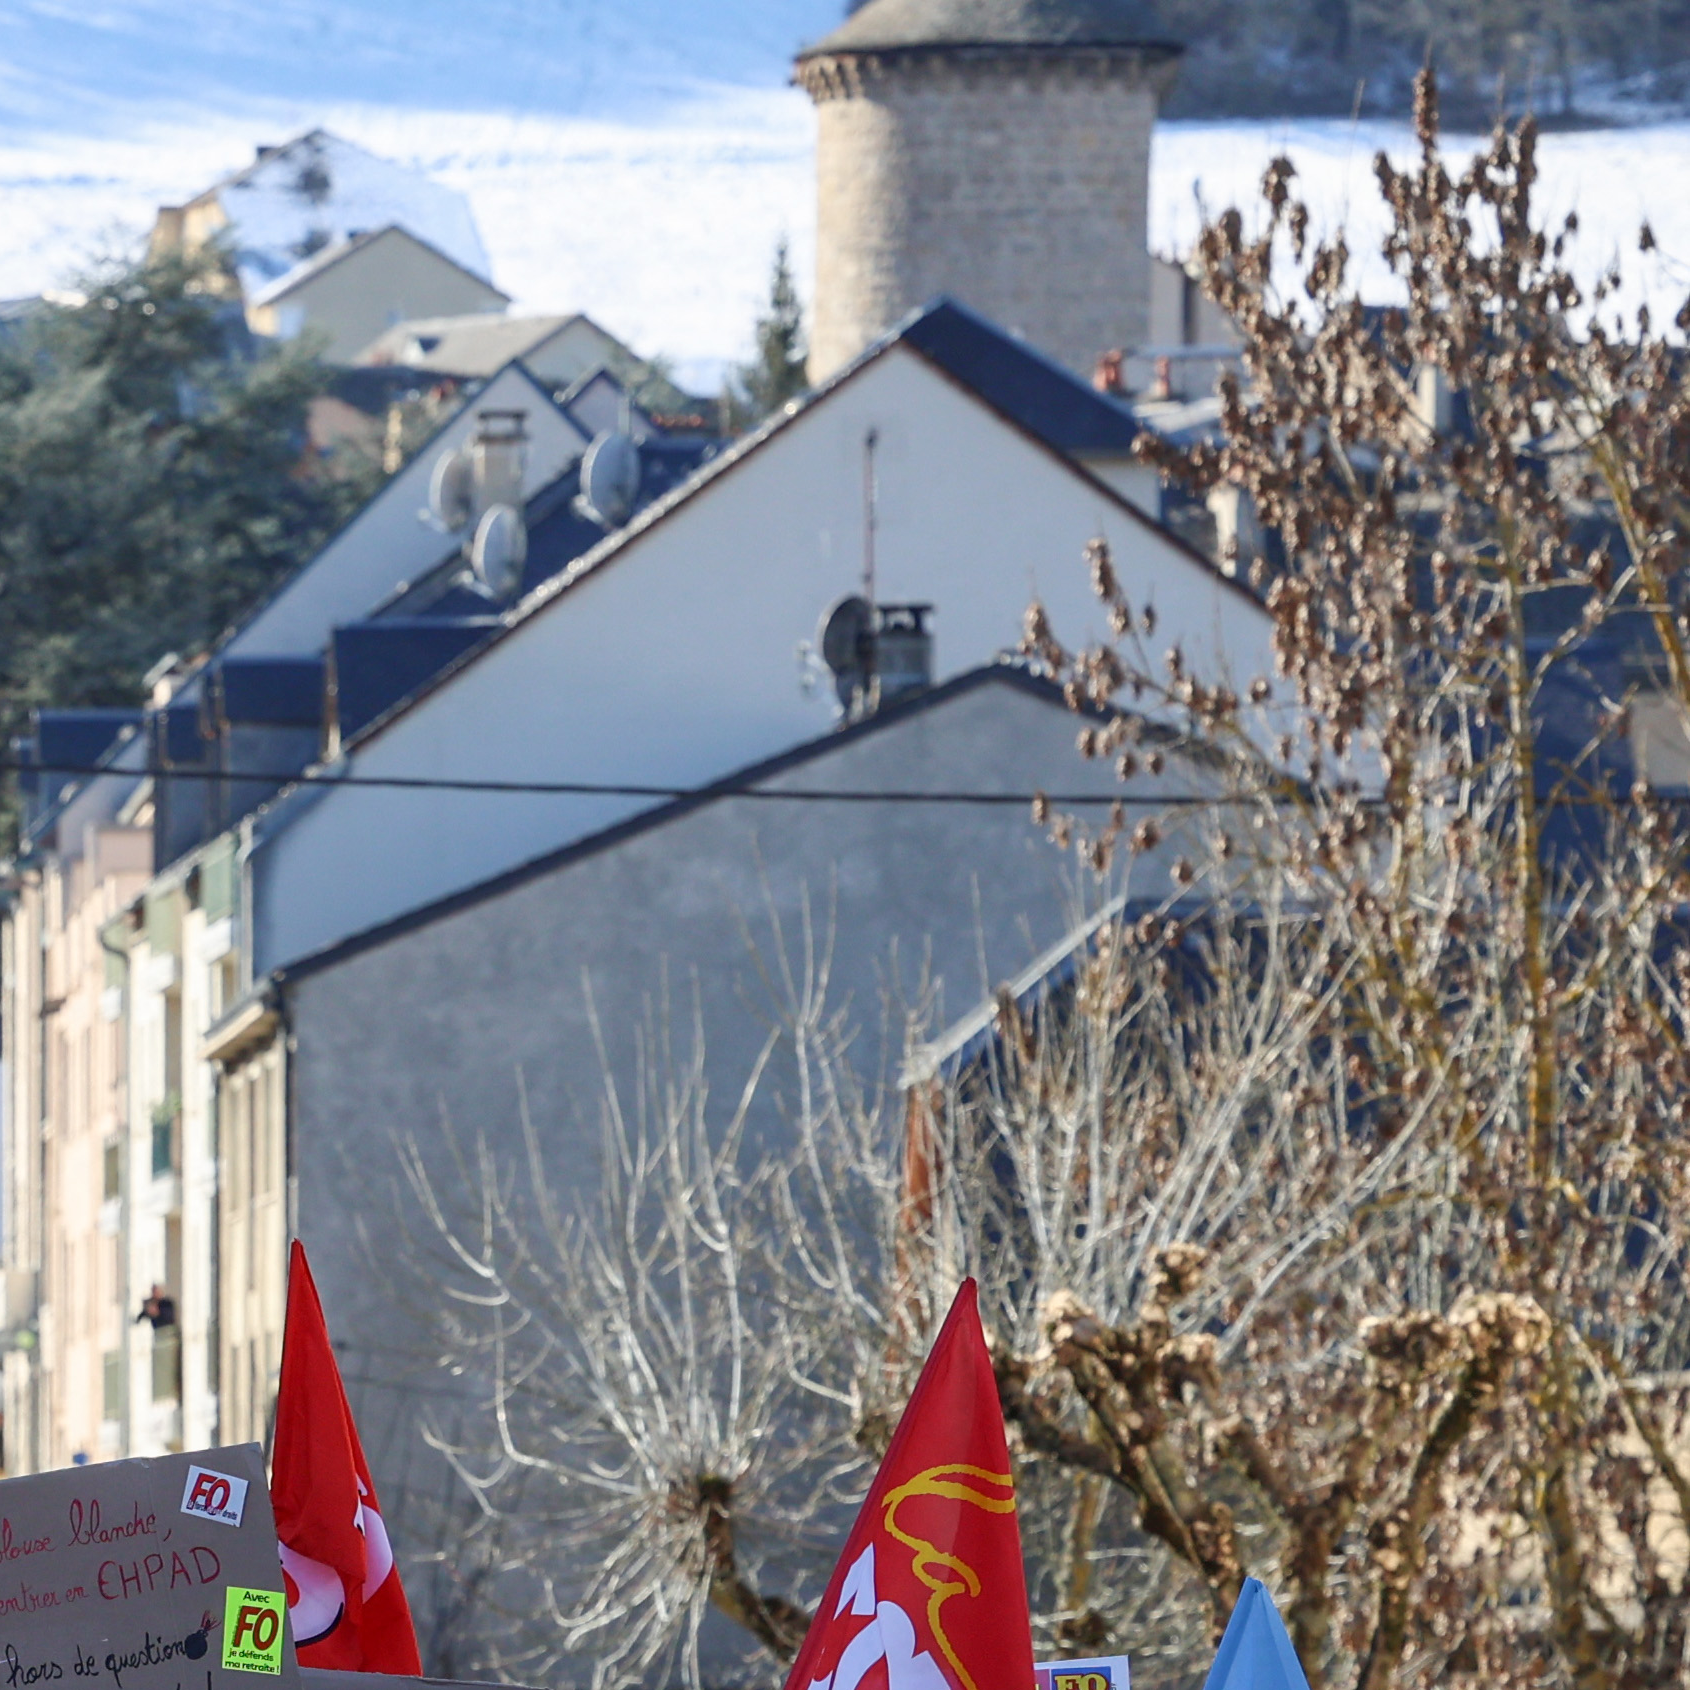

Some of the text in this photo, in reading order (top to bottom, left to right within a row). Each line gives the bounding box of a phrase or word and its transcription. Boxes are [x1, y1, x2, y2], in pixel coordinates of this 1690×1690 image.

[189, 1472, 231, 1514] FO
[97, 1546, 221, 1601] EHPAD
[243, 1591, 270, 1604] Avec
[233, 1605, 279, 1651] FO
[6, 1644, 63, 1689] hors
[73, 1645, 99, 1676] de
[105, 1632, 187, 1689] question
